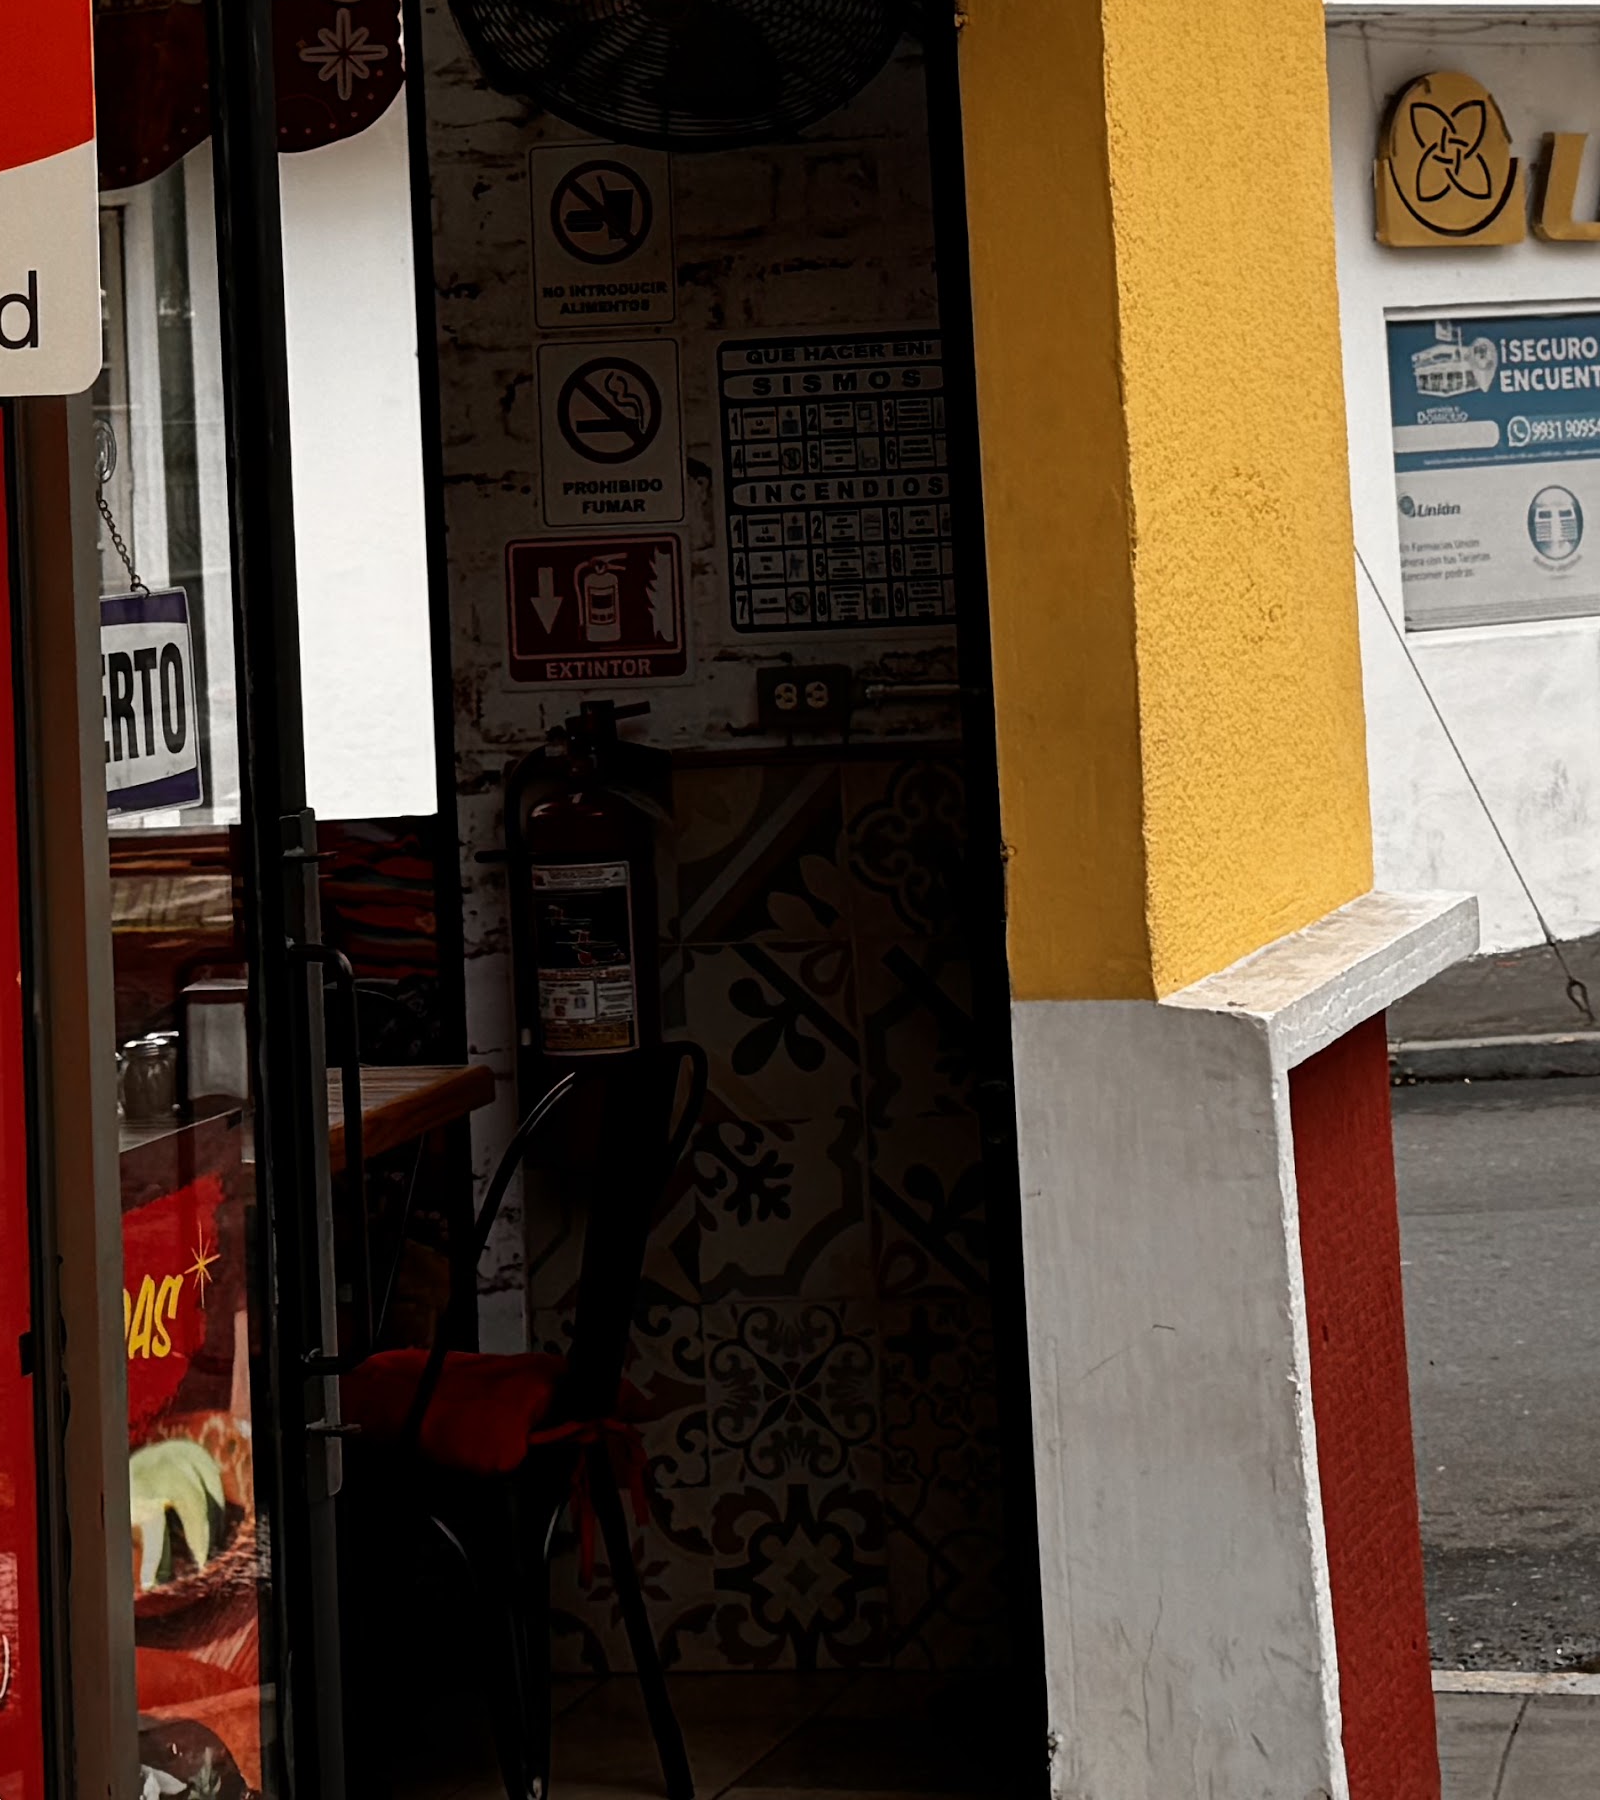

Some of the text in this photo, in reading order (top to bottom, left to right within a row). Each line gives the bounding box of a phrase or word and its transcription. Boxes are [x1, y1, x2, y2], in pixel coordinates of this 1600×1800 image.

[543, 280, 669, 299] NO INTRODUCIR
[559, 299, 651, 316] ALIMENTOS
[746, 349, 796, 365] QUE
[804, 343, 885, 361] HACER
[1500, 337, 1598, 363] ¡SEGURO
[753, 369, 922, 396] SISMOS
[563, 478, 663, 496] PROHIBIDO
[750, 476, 944, 504] INCENDIOS
[582, 498, 646, 515] FUMAR
[546, 658, 652, 680] EXTINTOR
